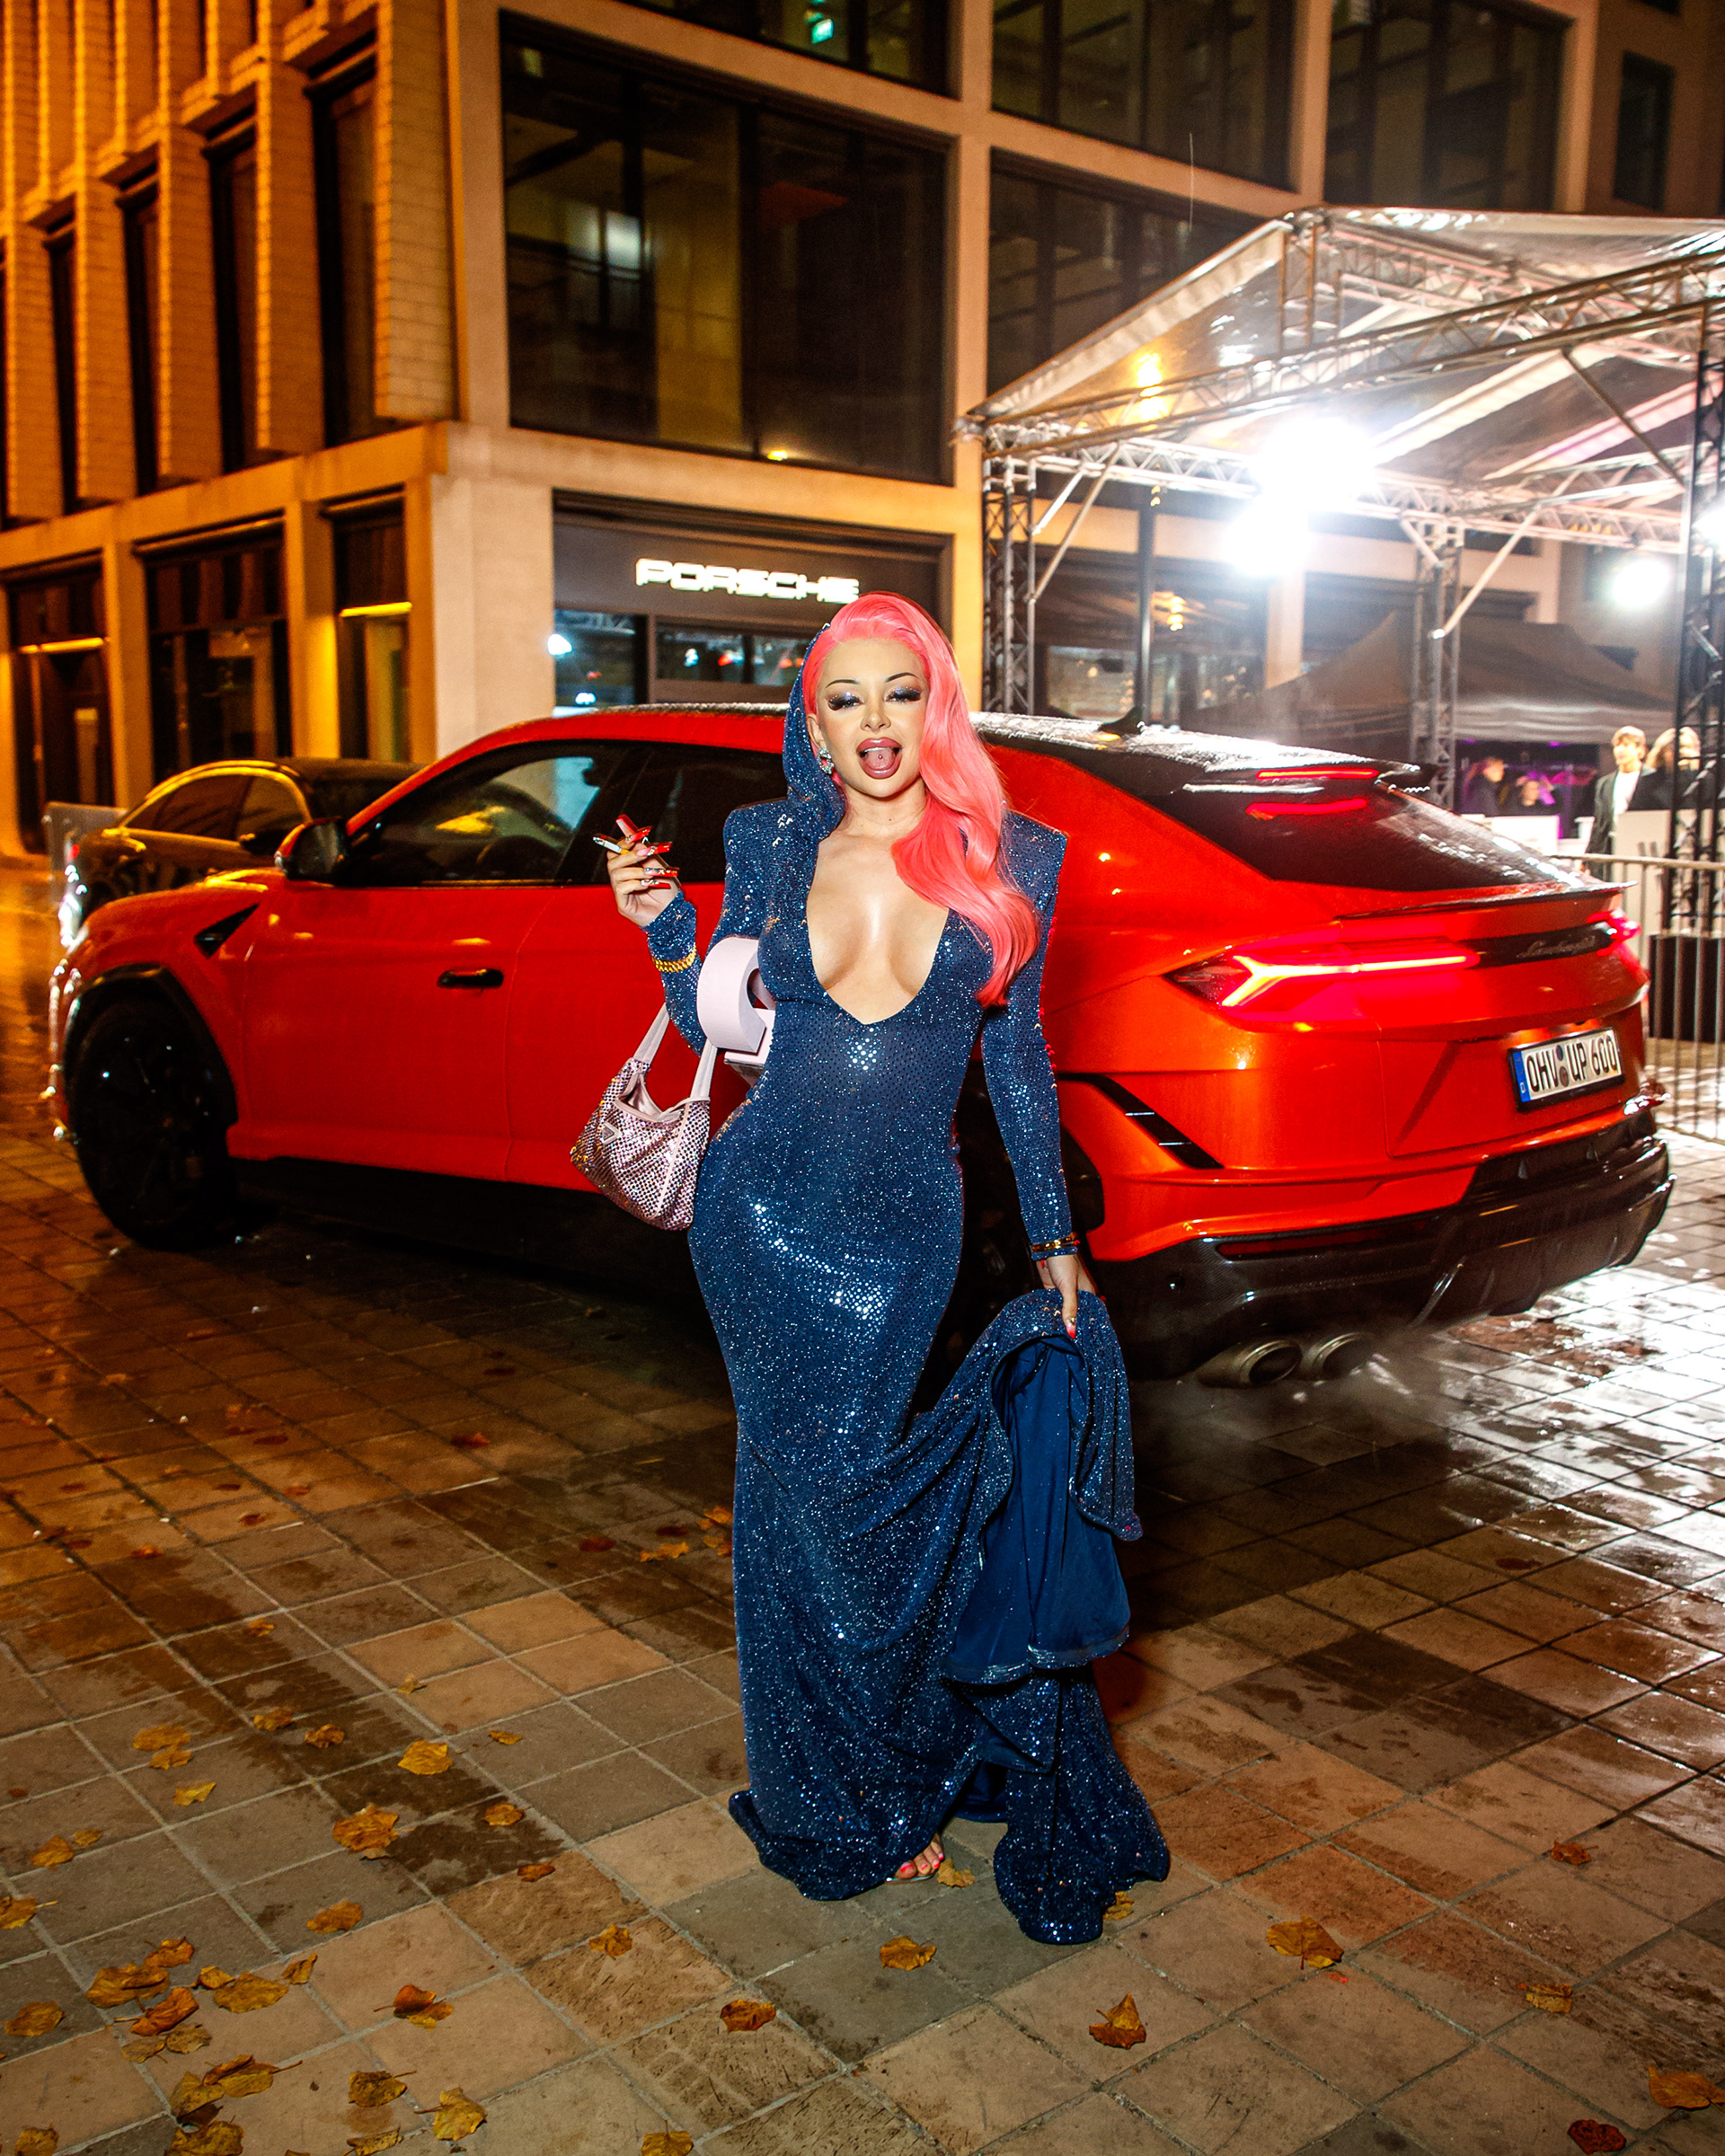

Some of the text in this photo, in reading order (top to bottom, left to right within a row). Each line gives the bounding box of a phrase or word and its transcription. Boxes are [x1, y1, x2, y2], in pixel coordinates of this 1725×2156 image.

[636, 558, 859, 604] PORSCHE
[1526, 1049, 1559, 1092] OHV
[1591, 1035, 1617, 1076] 600
